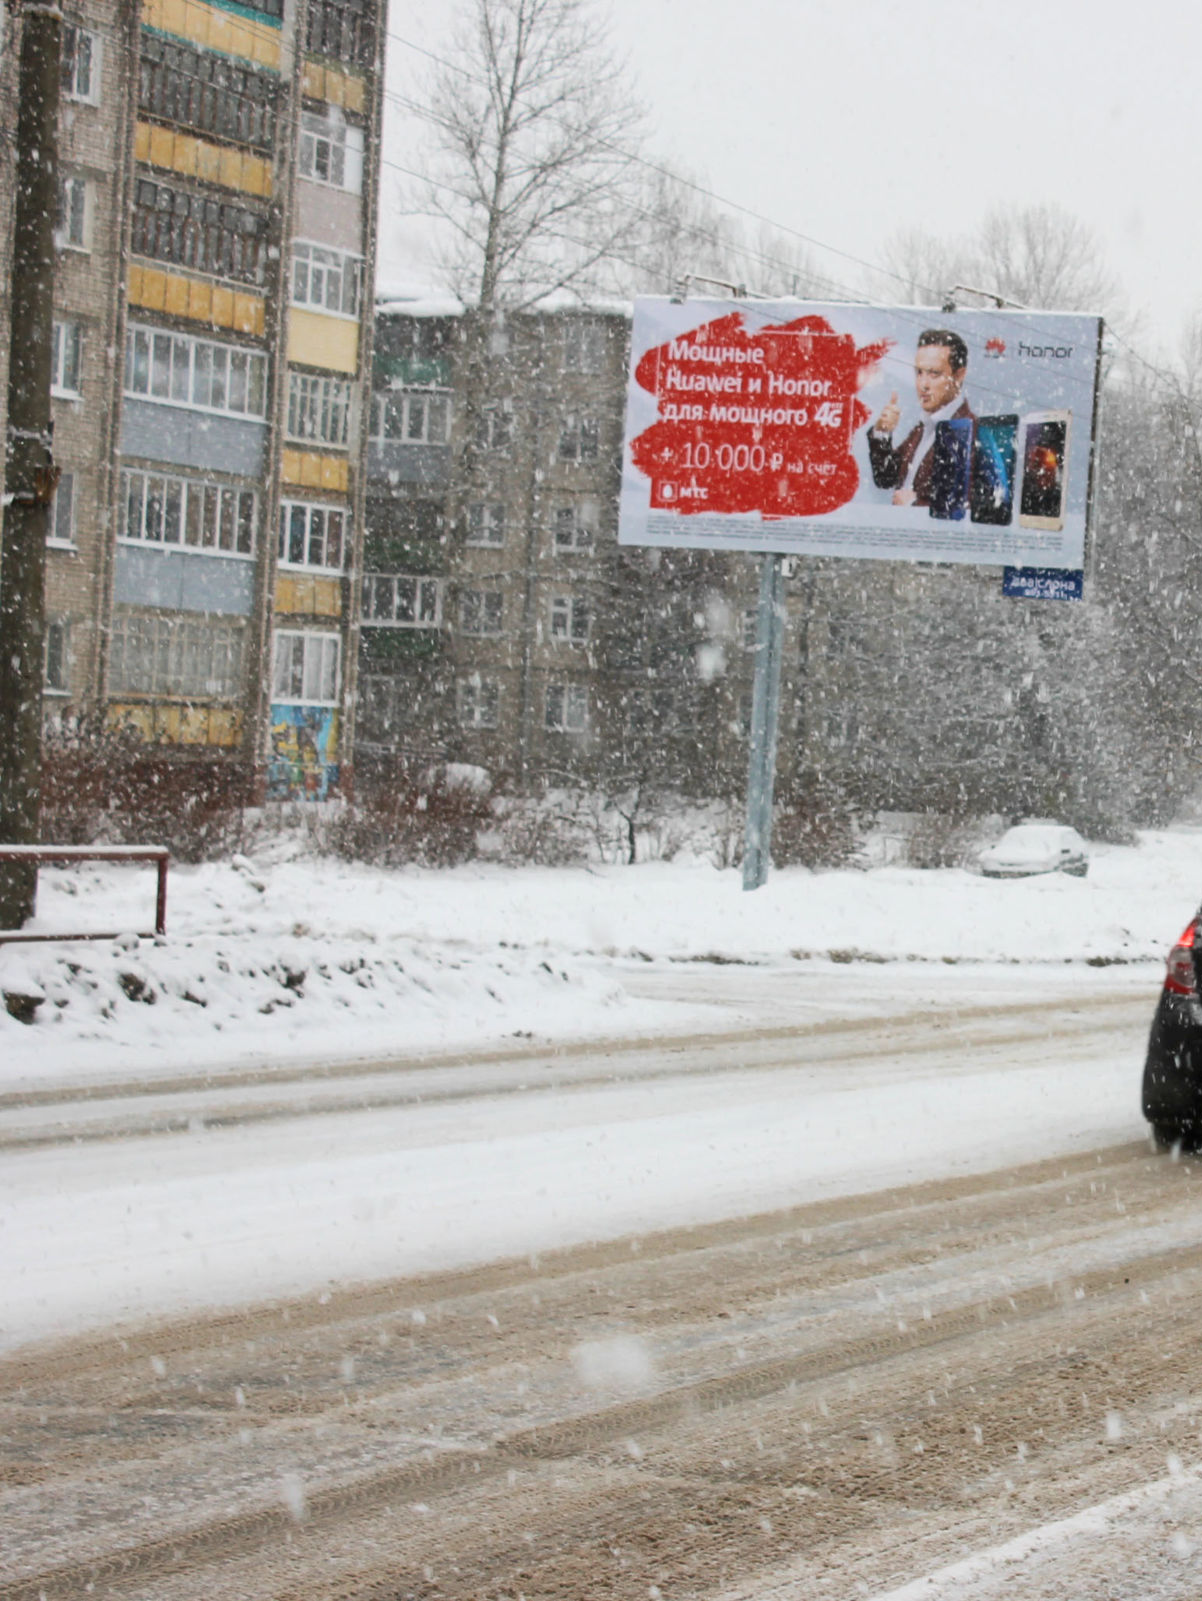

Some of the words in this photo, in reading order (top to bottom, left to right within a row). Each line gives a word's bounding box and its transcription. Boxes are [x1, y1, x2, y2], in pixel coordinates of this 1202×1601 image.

[668, 341, 764, 364] Мощные
[1018, 341, 1073, 358] honor
[666, 371, 743, 392] Huawei
[749, 379, 761, 393] и
[769, 375, 831, 395] Honor
[664, 405, 703, 422] для
[710, 406, 807, 425] мощного
[814, 402, 842, 427] 4G
[661, 447, 673, 460] +
[681, 443, 710, 469] 10
[718, 444, 765, 471] 000
[787, 463, 803, 473] на
